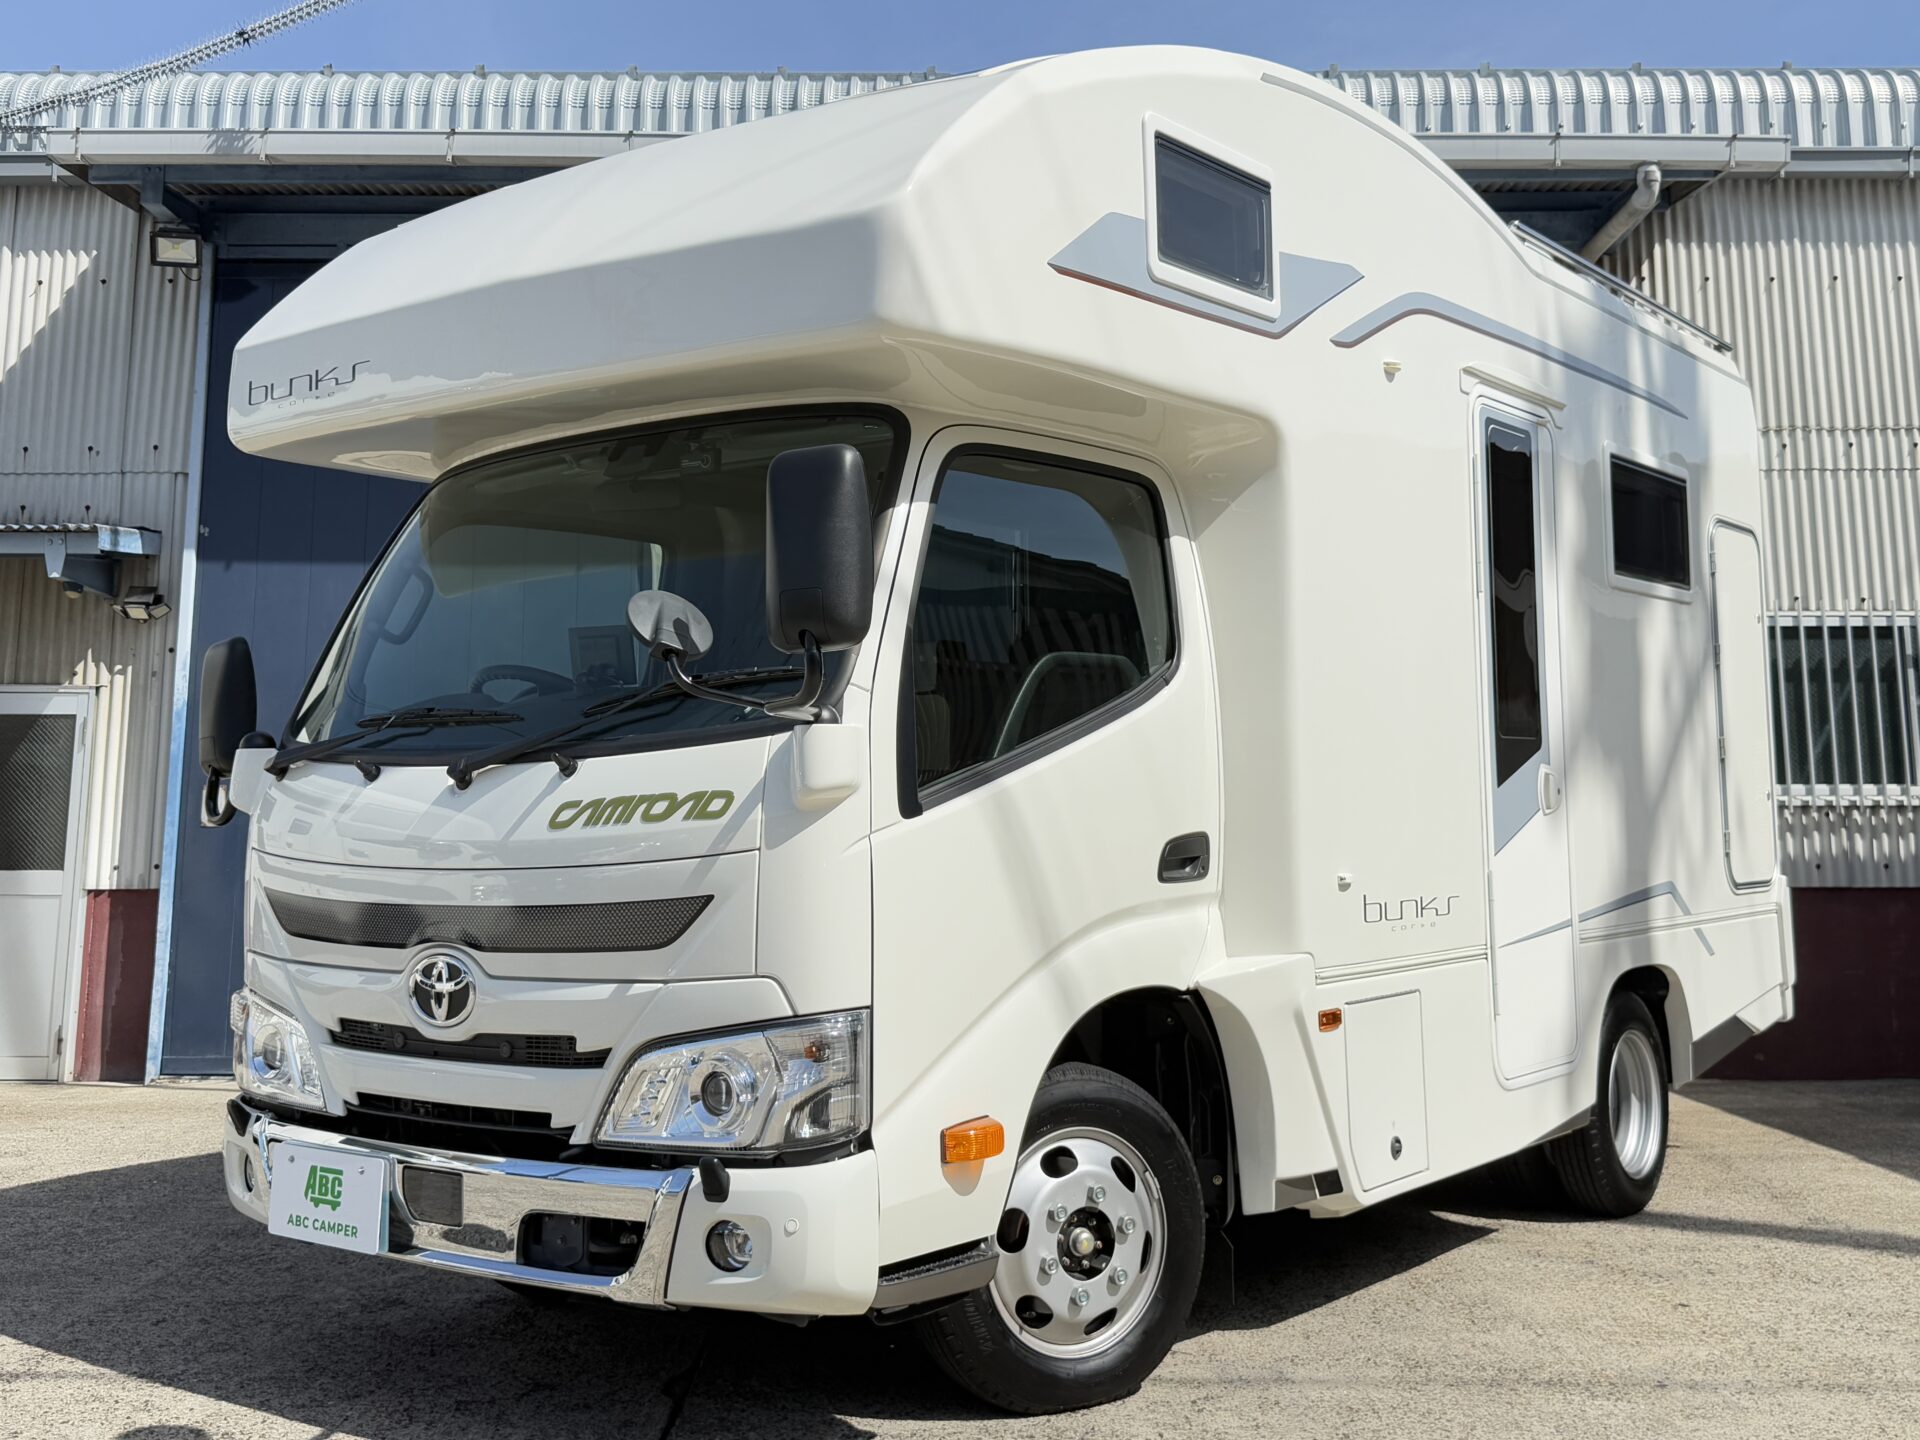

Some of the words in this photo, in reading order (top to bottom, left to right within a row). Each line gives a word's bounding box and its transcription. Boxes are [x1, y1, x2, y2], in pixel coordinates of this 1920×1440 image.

[248, 359, 371, 406] bunks
[548, 789, 735, 831] CAMROAD
[1363, 893, 1461, 924] bunks
[304, 1164, 344, 1201] ABC
[287, 1213, 310, 1229] ABC
[312, 1218, 359, 1239] CAMPER
